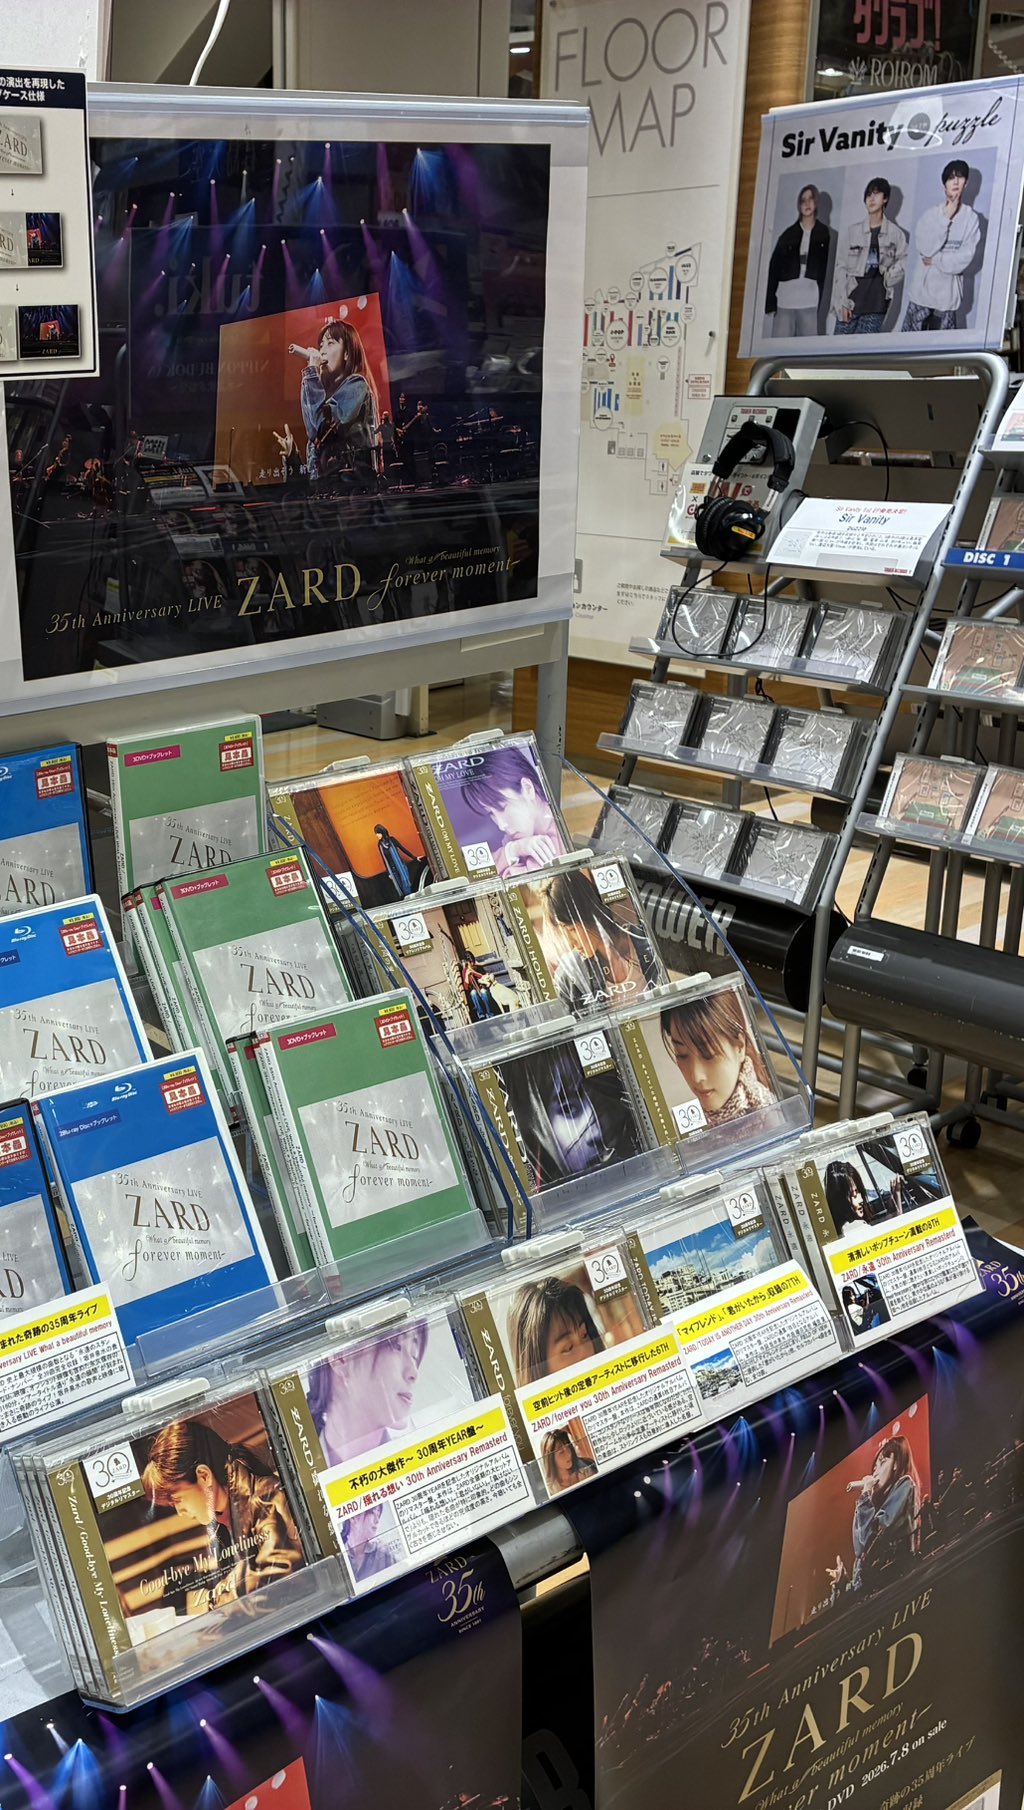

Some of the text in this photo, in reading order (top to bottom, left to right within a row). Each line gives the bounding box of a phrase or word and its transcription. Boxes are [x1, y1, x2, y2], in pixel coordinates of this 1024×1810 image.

[555, 1, 729, 93] FLOOR
[872, 58, 938, 86] ROIROM
[586, 82, 696, 158] MAP
[781, 128, 816, 158] Sir
[820, 120, 906, 154] Vanity
[927, 96, 1003, 147] puzzle
[839, 513, 890, 525] Sir Vanity
[405, 546, 501, 565] What beautiful memory
[963, 551, 1011, 566] DISC 1
[237, 563, 362, 618] ZARD
[367, 563, 446, 610] forever
[45, 594, 223, 634] 35th Anniversary LIVE
[444, 769, 475, 780] MY LOVE
[170, 835, 232, 869] ZARD
[637, 882, 736, 956] OWER
[230, 944, 308, 971] 35th Anniversary LIVE
[529, 952, 546, 987] HOLD
[240, 963, 316, 999] ZARD
[22, 1028, 106, 1065] ZARD
[336, 1100, 413, 1129] 35th Anniversary LIVE
[345, 1121, 420, 1160] ZARD
[116, 1173, 204, 1198] 35th Anniversary LIVE
[342, 1163, 394, 1203] forever
[125, 1194, 211, 1232] ZARD
[2, 1252, 20, 1263] LIVE
[122, 1239, 181, 1281] forever
[876, 1256, 892, 1267] 30th
[24, 1348, 38, 1360] LIVE
[39, 1342, 55, 1356] What
[61, 1328, 88, 1346] beautiful
[89, 1320, 113, 1335] memory
[481, 1327, 506, 1391] ZARD
[531, 1356, 682, 1432] ZARD/forever you 30th Anniversary Remasterd
[405, 1471, 425, 1486] 30th
[426, 1451, 468, 1477] Anniversary
[469, 1432, 508, 1458] Remasterd
[67, 1495, 120, 1660] Zard Good-bye My Loneliness
[139, 1564, 192, 1598] Good-bye
[192, 1553, 212, 1574] My
[212, 1528, 271, 1568] Loneliness
[192, 1573, 240, 1607] Zard
[437, 1568, 486, 1622] 35th
[776, 1587, 934, 1711] Anniversary LIVE
[738, 1632, 924, 1805] ZARD
[808, 1701, 905, 1777] beautiful memory
[860, 1717, 949, 1787] 2026.7.8 on sale
